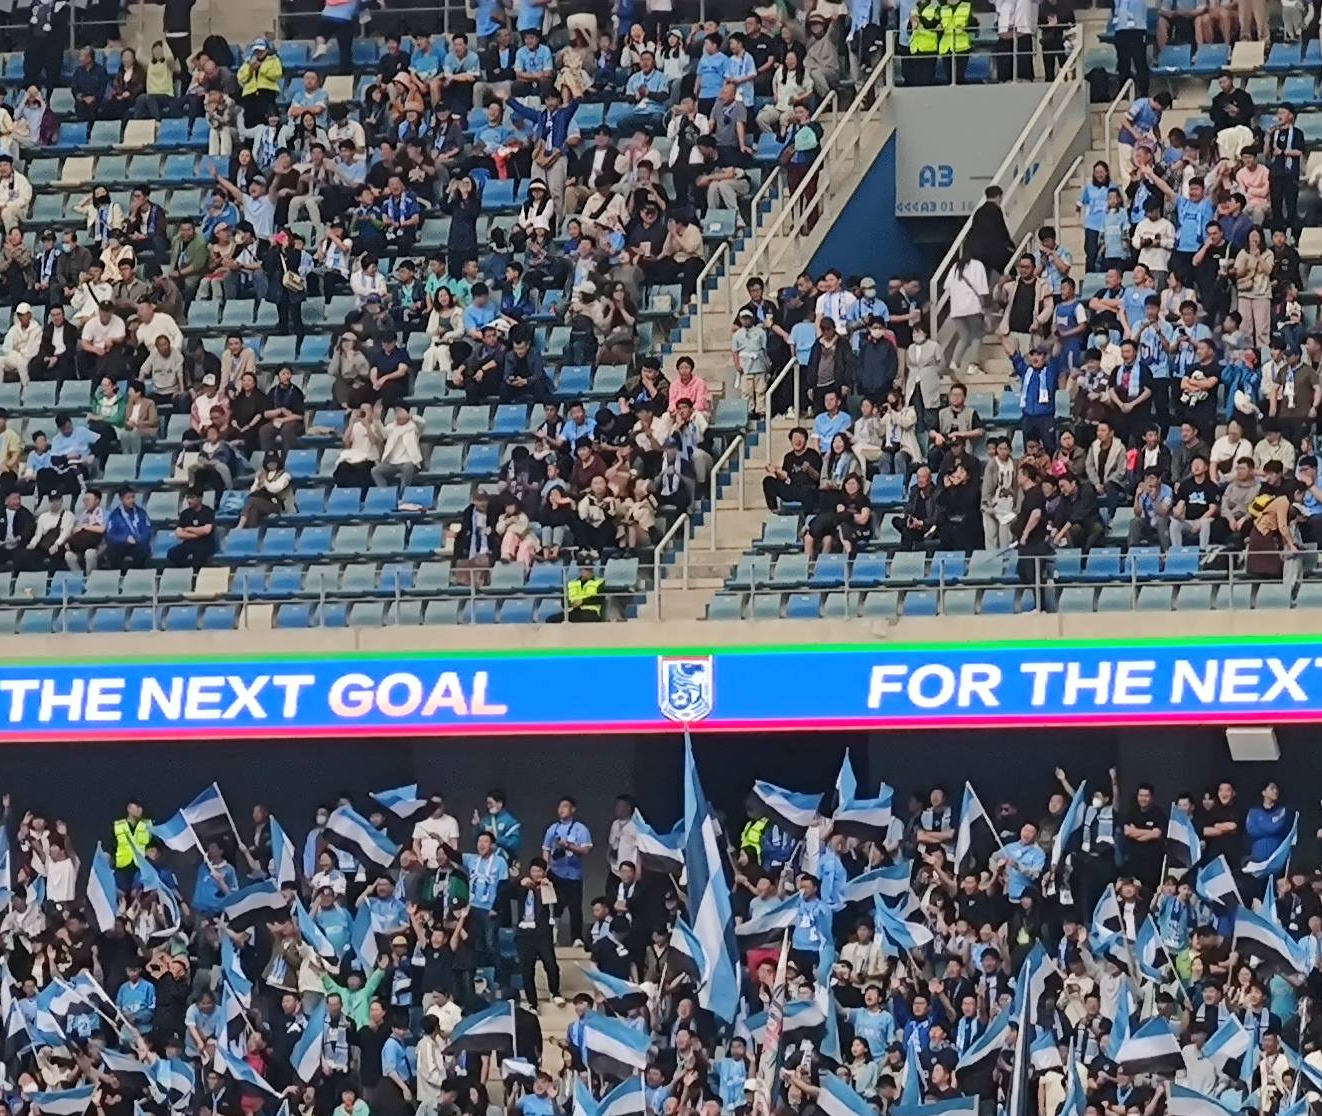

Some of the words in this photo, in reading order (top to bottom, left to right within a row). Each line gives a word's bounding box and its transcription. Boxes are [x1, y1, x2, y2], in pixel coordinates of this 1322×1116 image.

[919, 165, 953, 188] A3
[0, 679, 125, 722] THE
[138, 675, 315, 720] NEXT
[329, 672, 507, 717] GOAL
[868, 664, 1002, 708] FOR
[1021, 661, 1155, 705] THE
